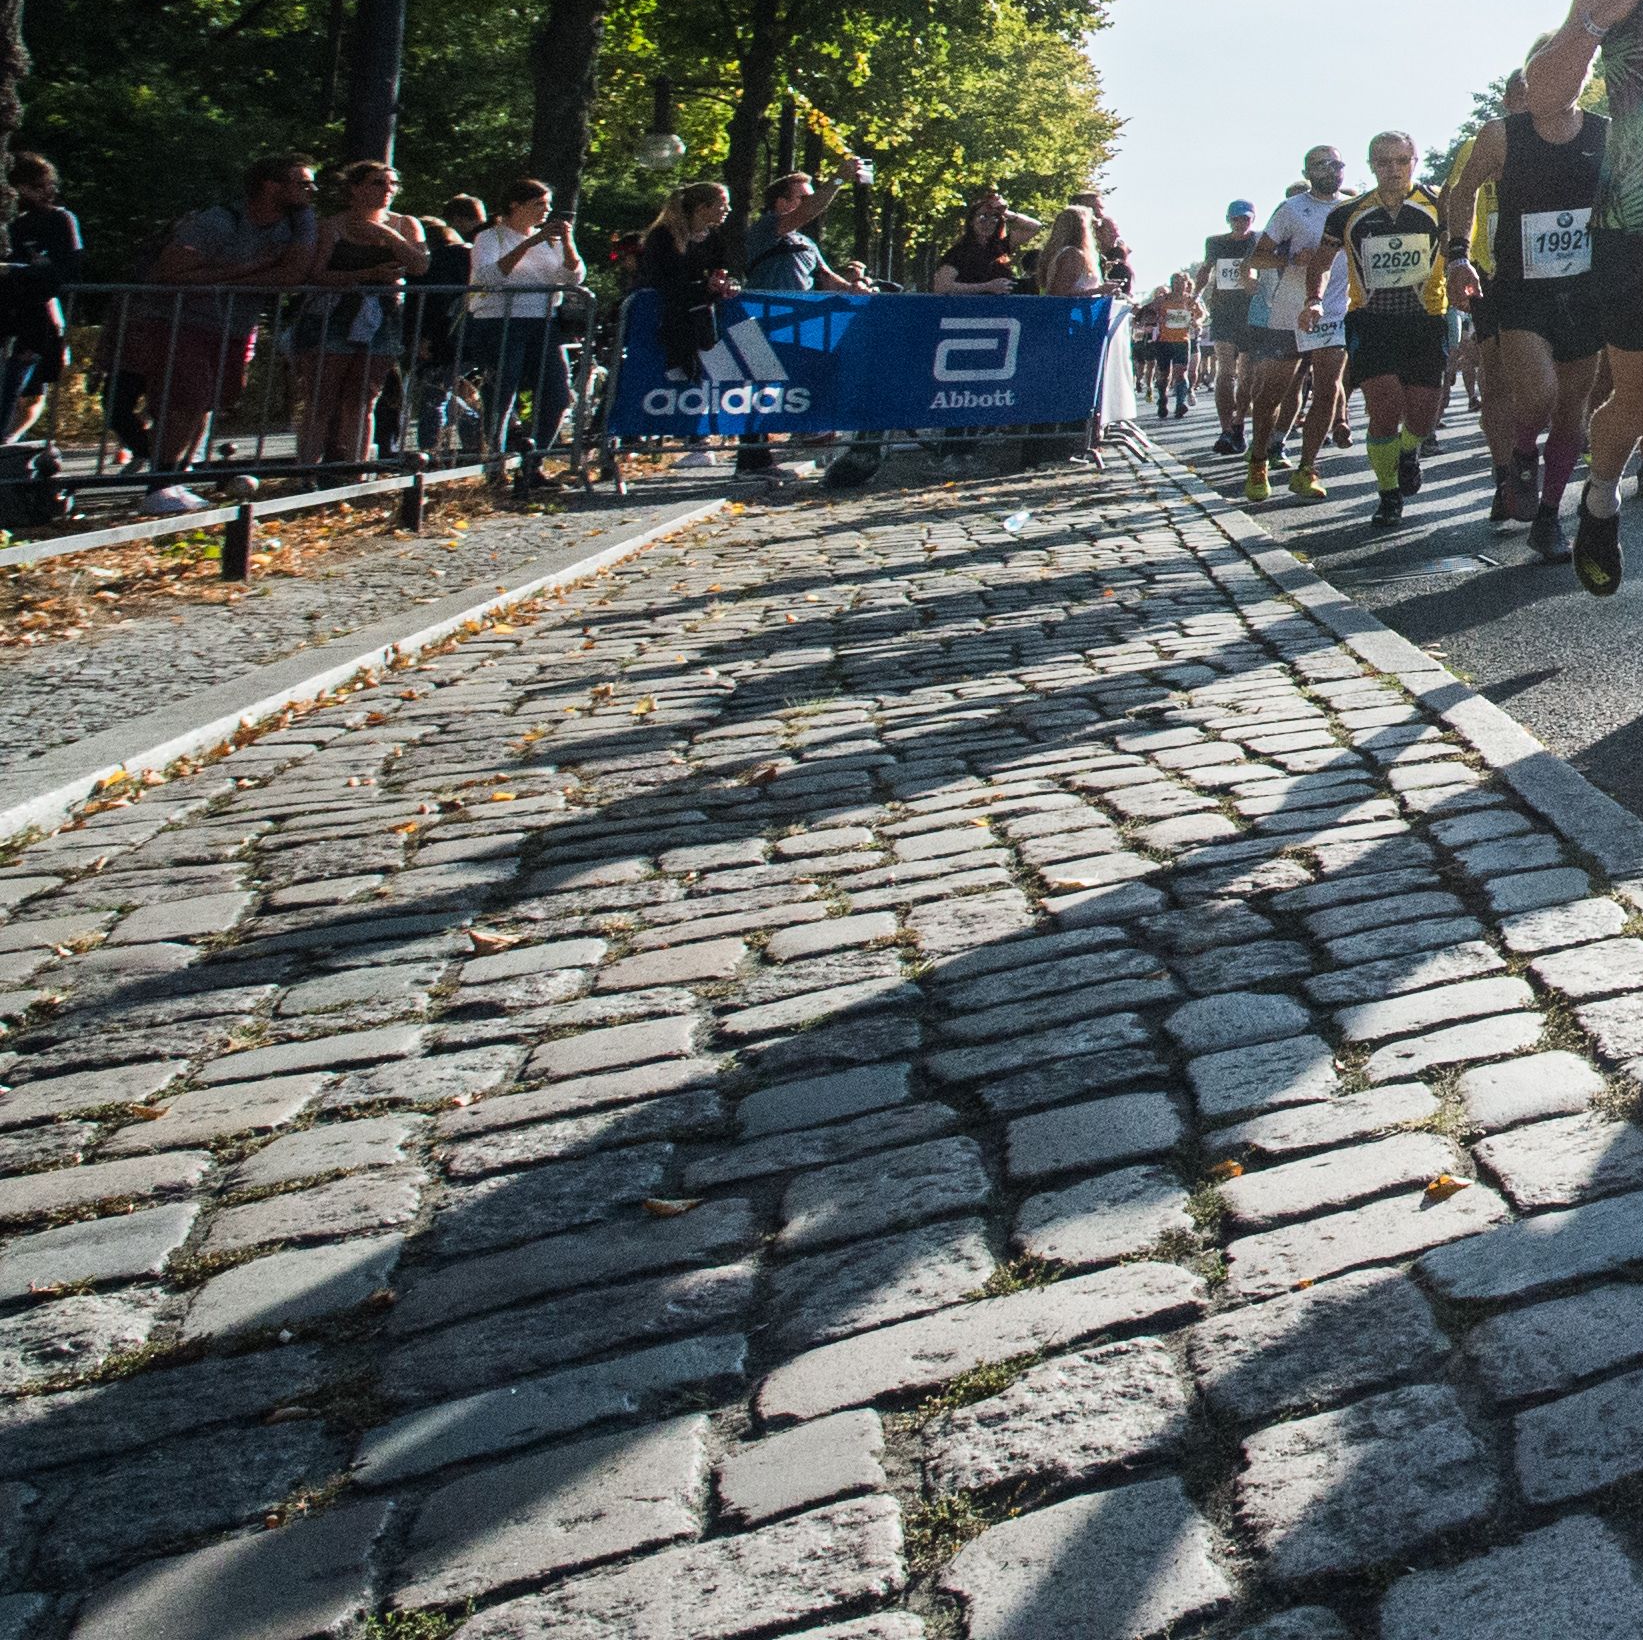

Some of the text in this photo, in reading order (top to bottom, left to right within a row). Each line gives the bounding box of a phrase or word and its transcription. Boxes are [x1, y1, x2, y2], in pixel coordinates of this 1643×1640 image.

[1535, 229, 1591, 254] 19921
[1371, 250, 1421, 269] 22620
[643, 380, 812, 415] adidas
[929, 389, 1015, 410] Abbott
